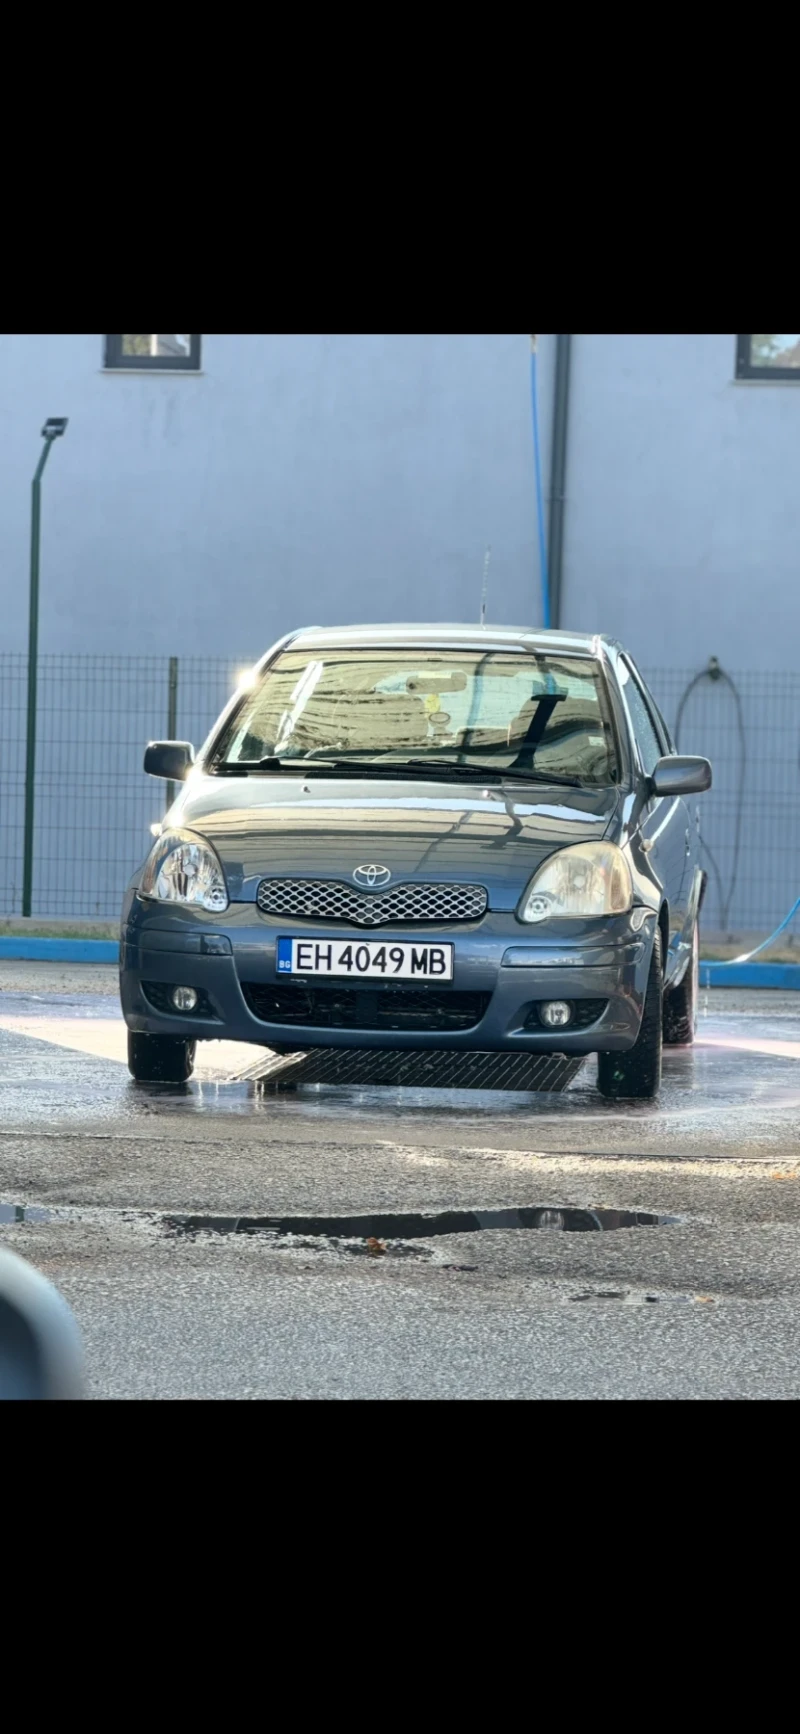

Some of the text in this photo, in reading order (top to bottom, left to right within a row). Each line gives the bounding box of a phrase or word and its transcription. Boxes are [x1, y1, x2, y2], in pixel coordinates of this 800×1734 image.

[279, 960, 291, 968] BG
[296, 943, 446, 975] EH 4049 MB
